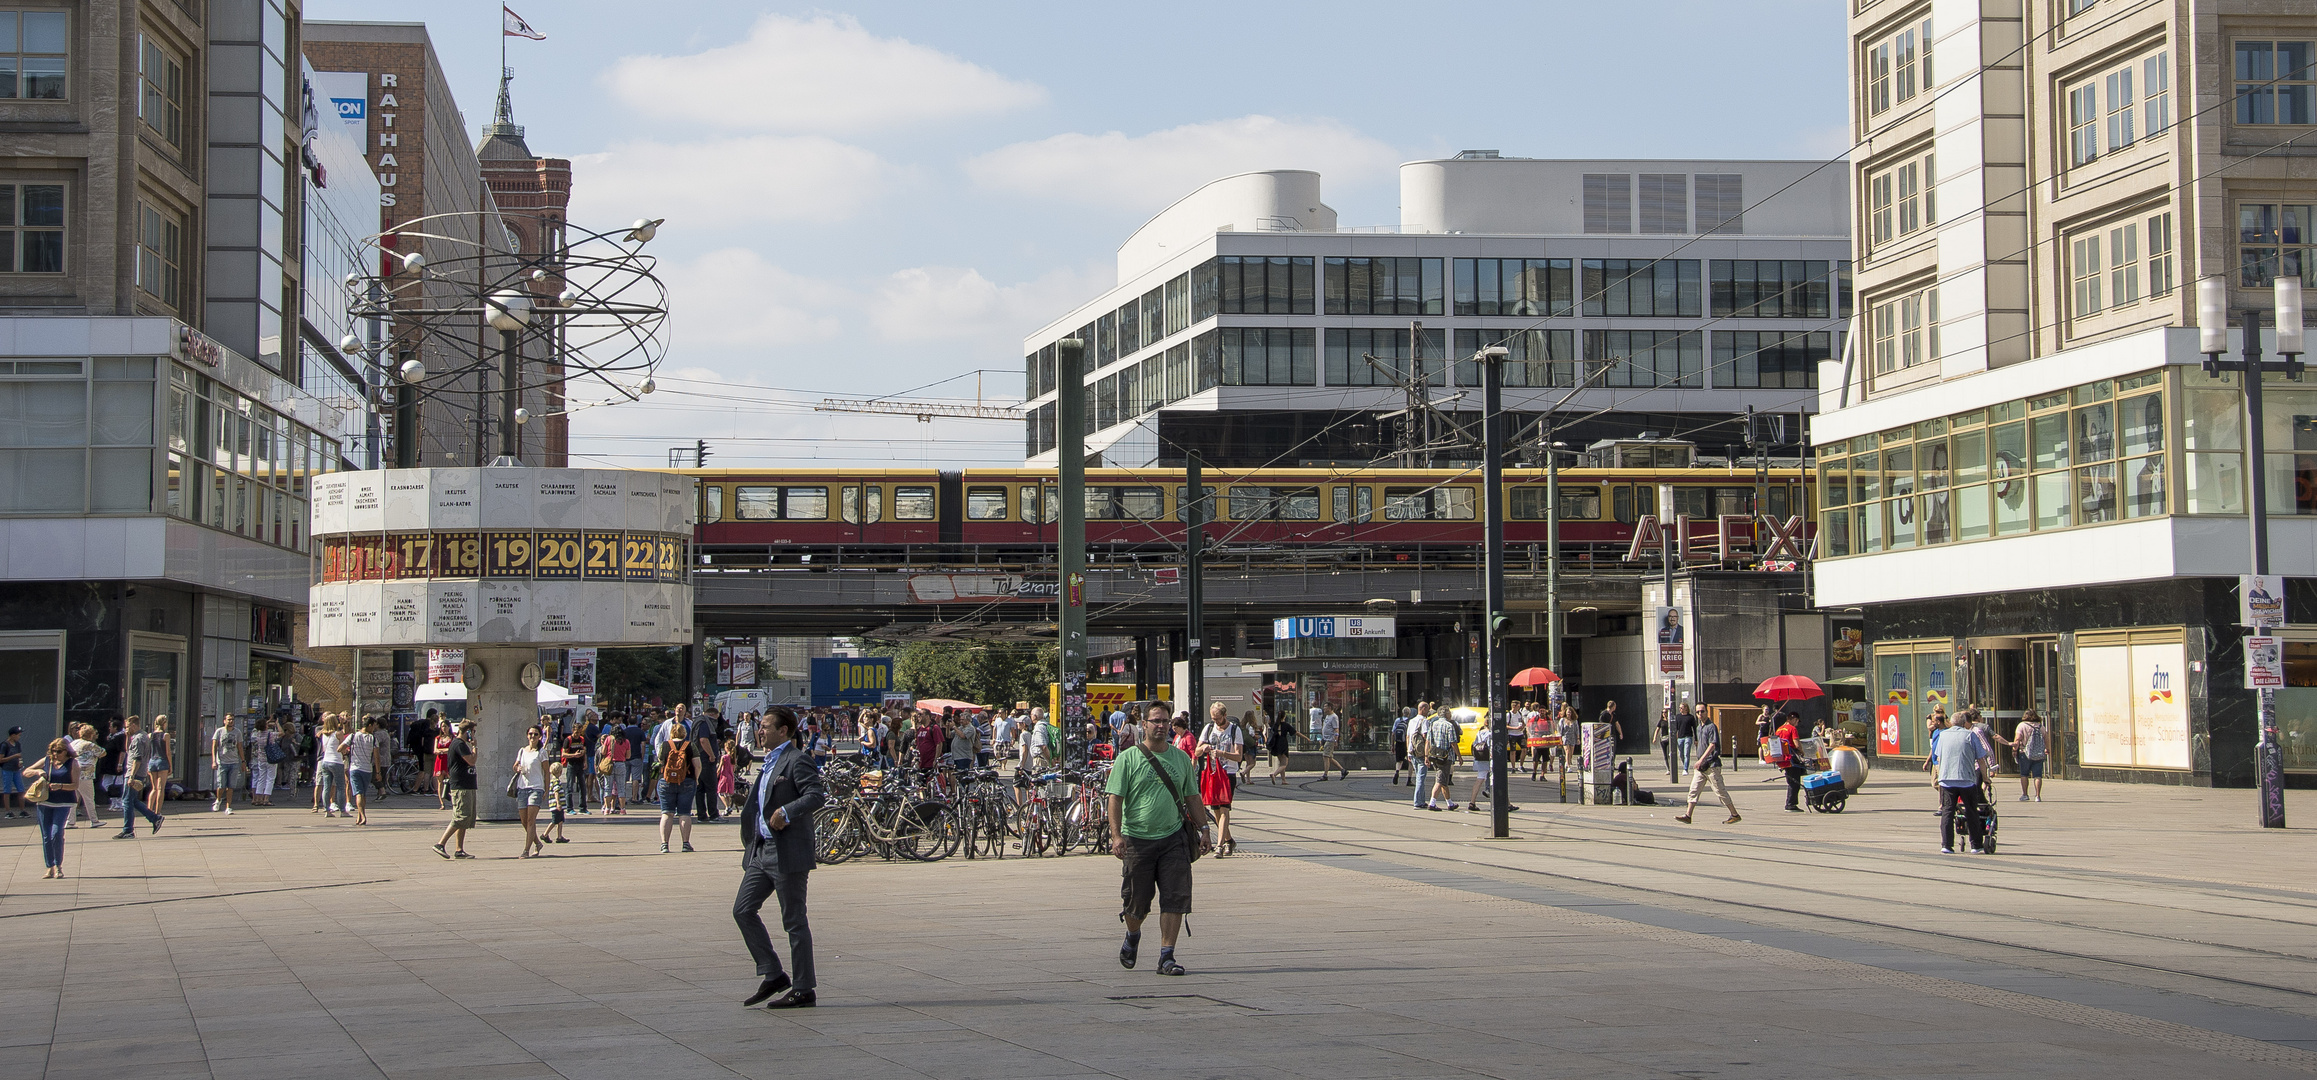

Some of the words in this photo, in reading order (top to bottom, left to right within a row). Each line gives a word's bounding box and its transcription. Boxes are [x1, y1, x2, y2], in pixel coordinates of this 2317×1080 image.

[379, 73, 399, 207] RATHAUS
[1628, 514, 1818, 562] ALEX
[338, 545, 357, 571] 15
[364, 541, 391, 570] 16
[402, 540, 434, 568] 17
[447, 539, 479, 568] 18
[494, 539, 531, 568] 19
[539, 539, 581, 568] 20
[588, 540, 617, 568] 21
[626, 541, 653, 569] 22
[656, 543, 673, 571] 23
[1300, 619, 1313, 636] U
[1332, 662, 1379, 670] Alexanderplatz
[1892, 664, 1906, 689] dm
[1930, 663, 1945, 688] dm
[2152, 664, 2169, 689] dm
